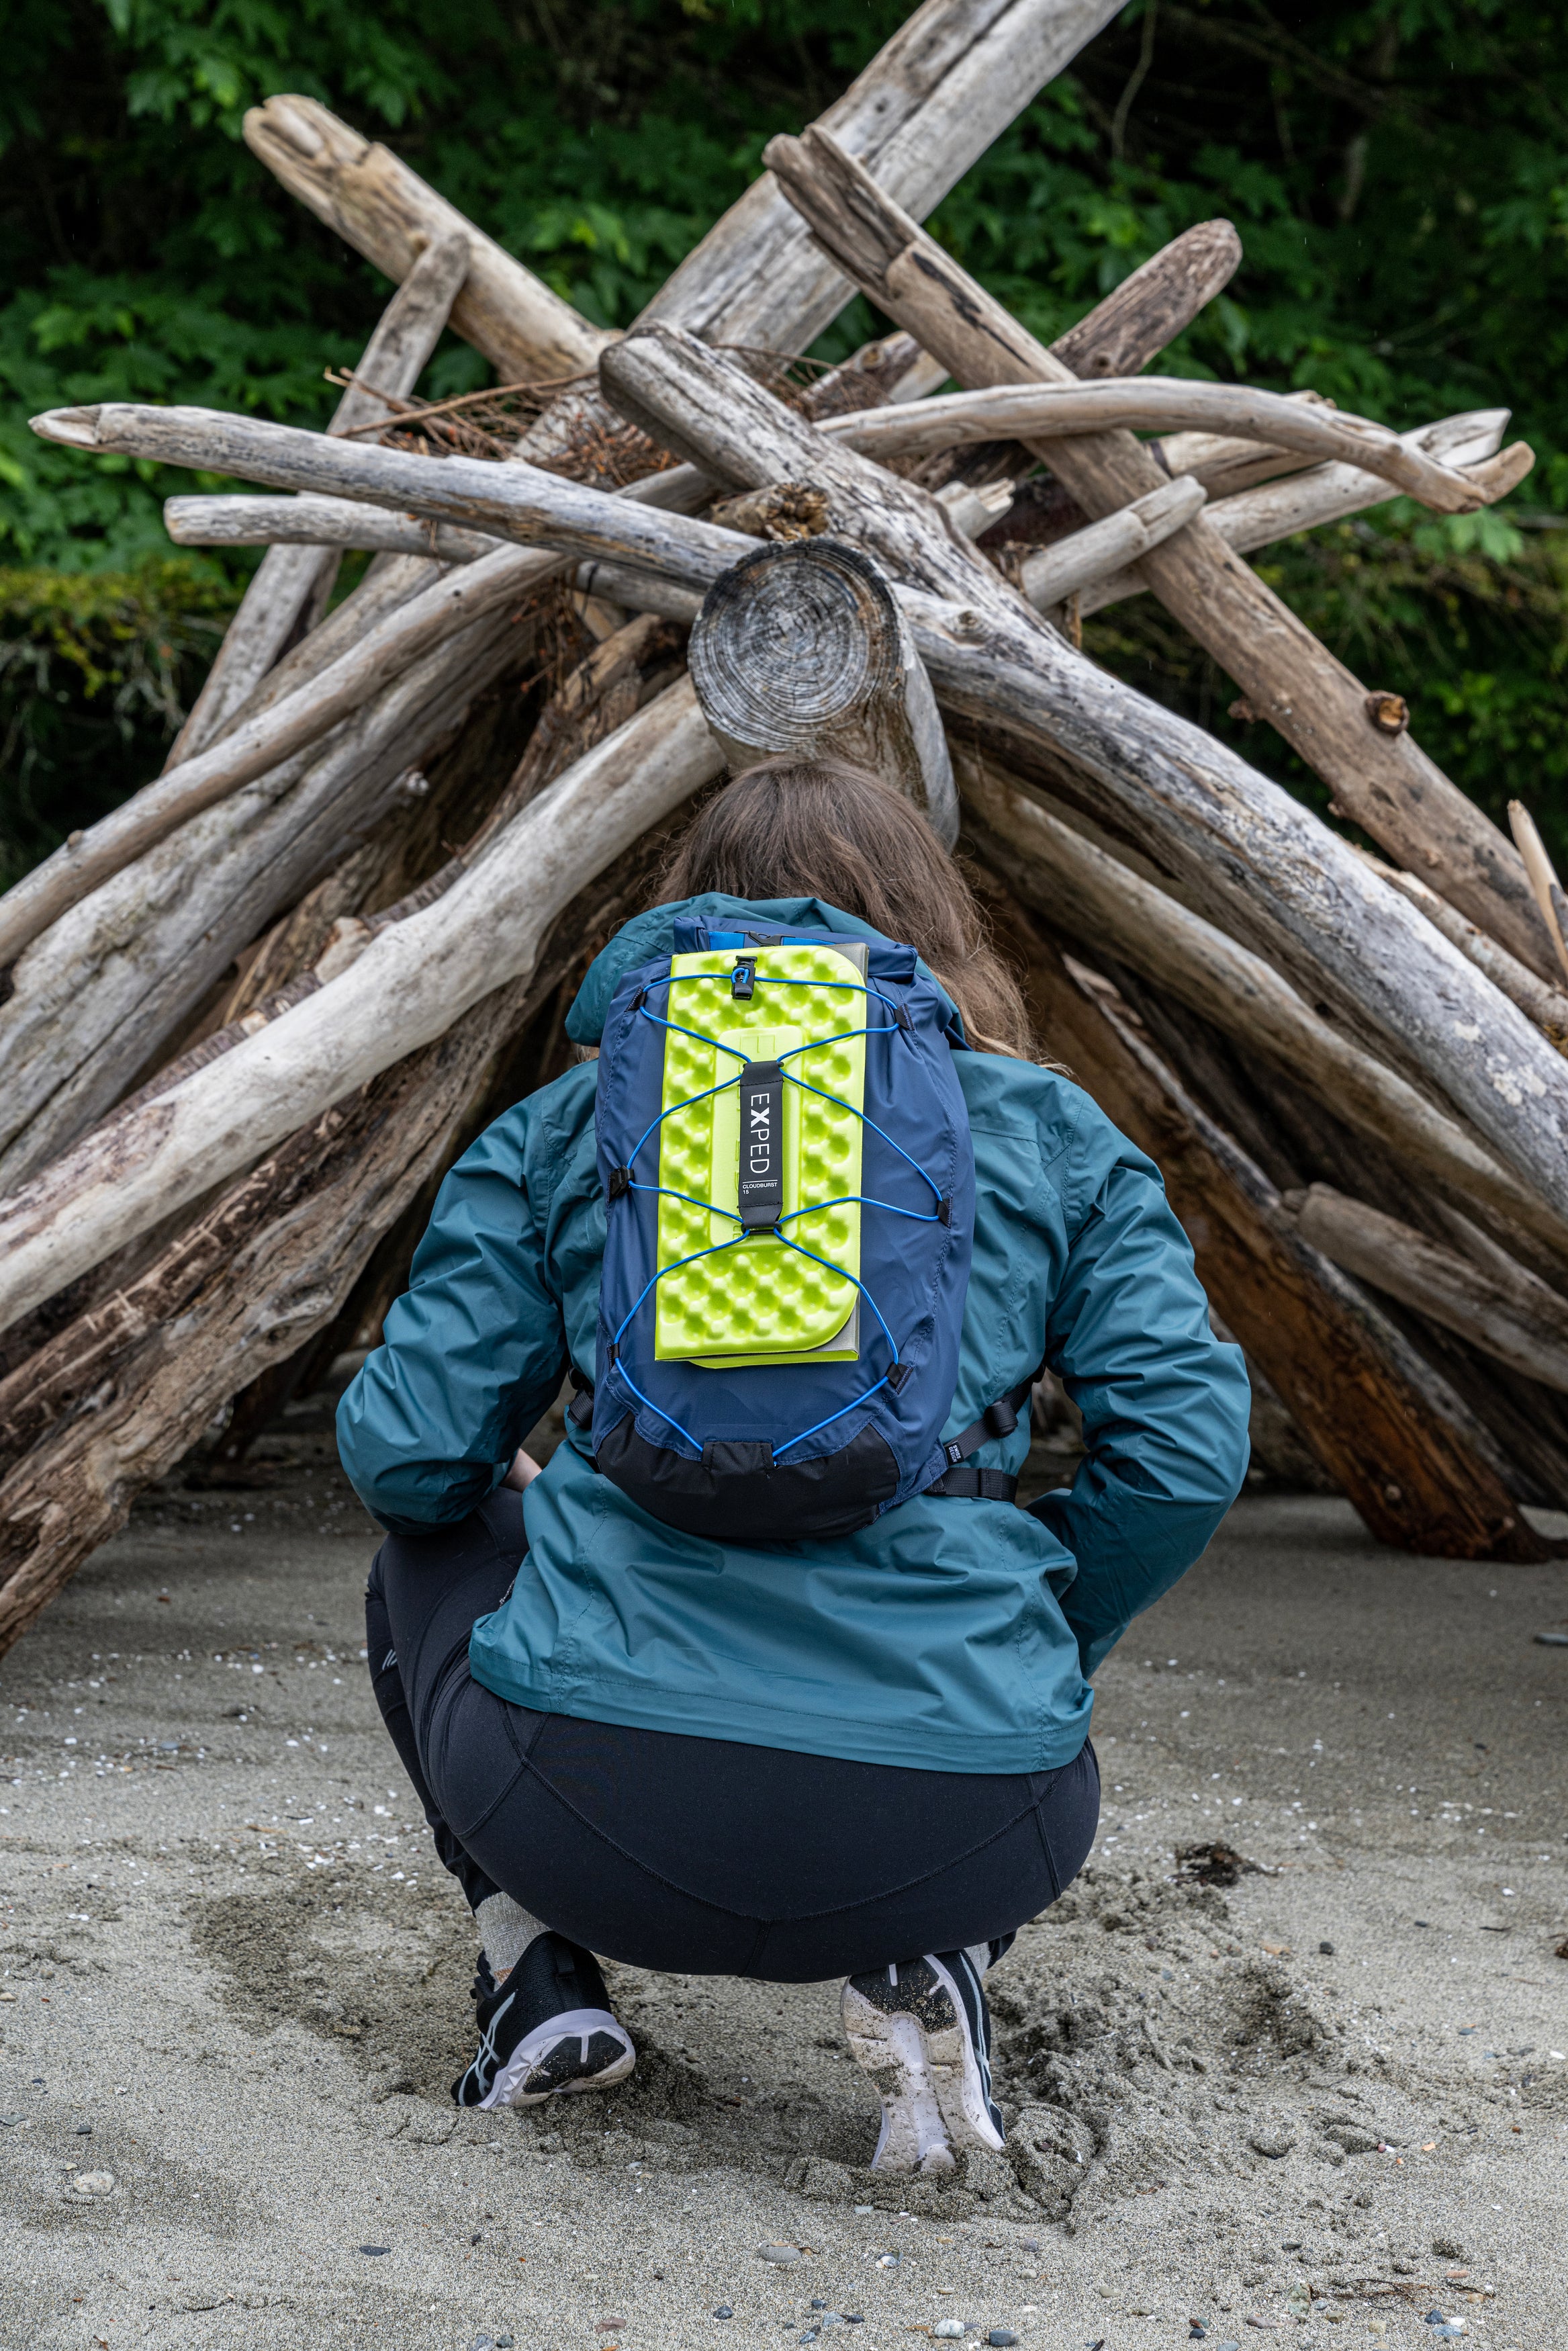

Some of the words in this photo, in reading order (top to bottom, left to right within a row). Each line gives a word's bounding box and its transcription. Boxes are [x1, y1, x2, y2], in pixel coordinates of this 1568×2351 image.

[750, 1093, 770, 1173] EXPED
[948, 1447, 958, 1462] DESIGN
[952, 1445, 962, 1459] SWISS
